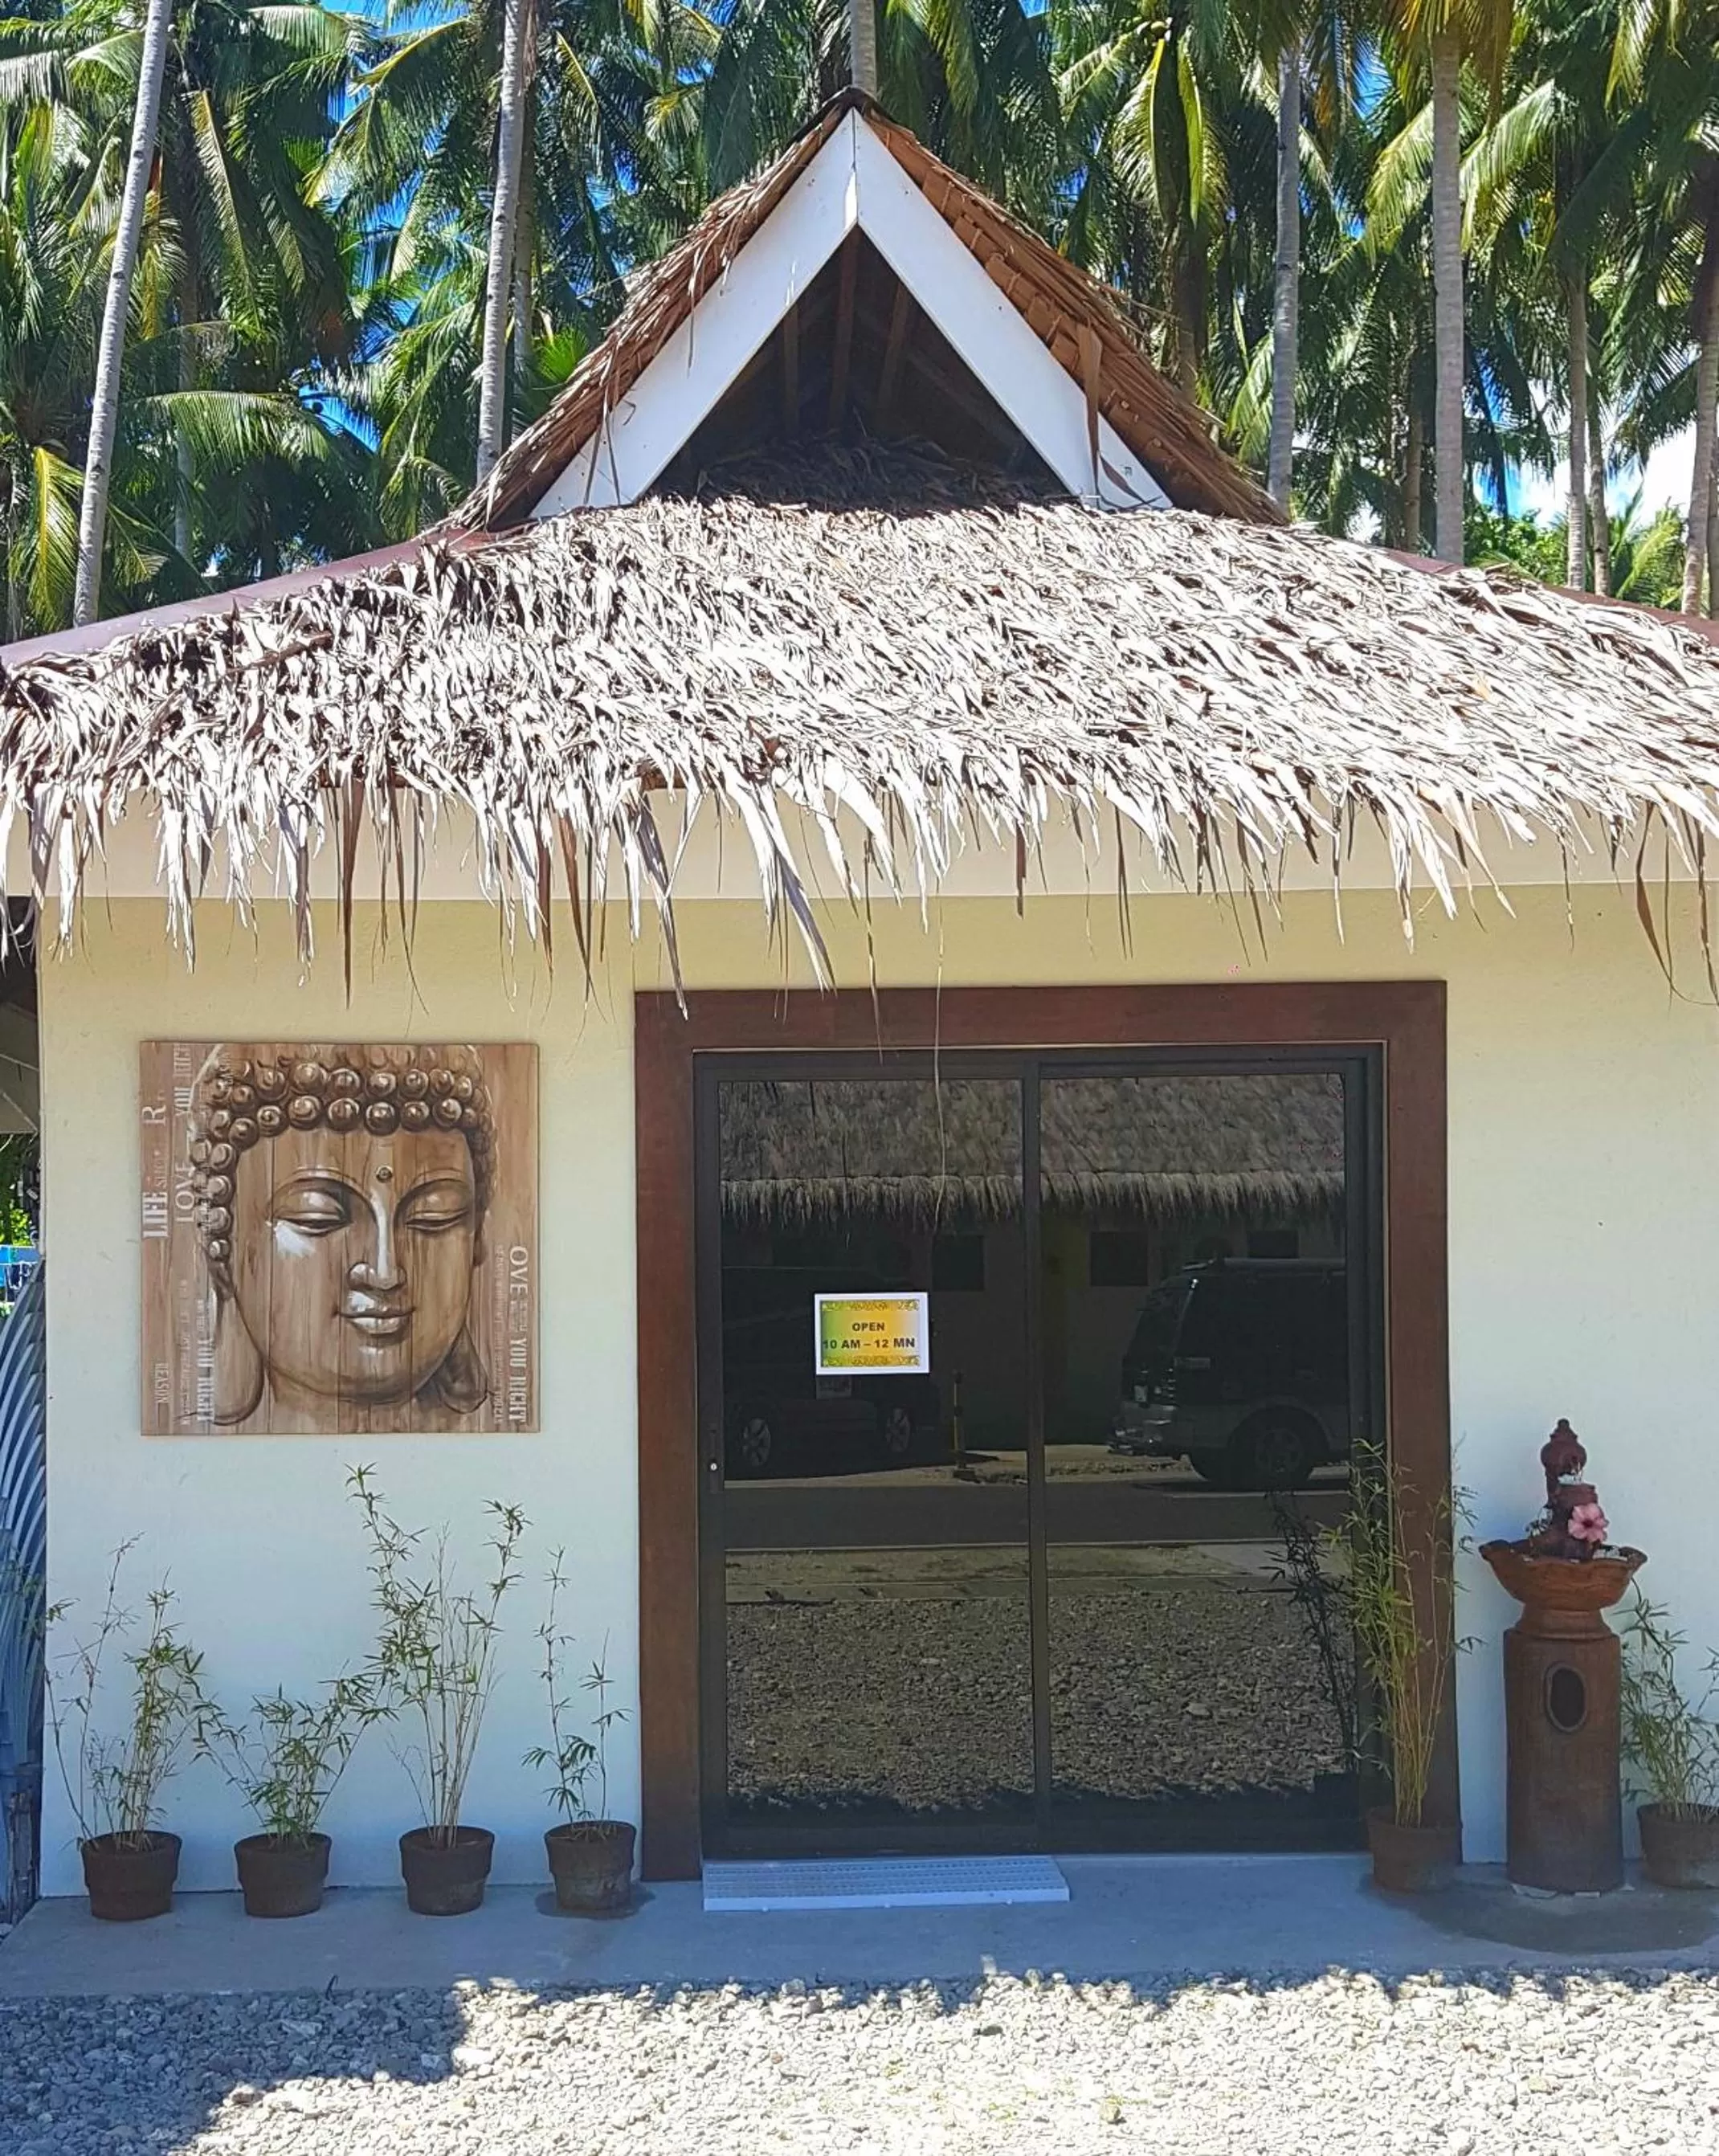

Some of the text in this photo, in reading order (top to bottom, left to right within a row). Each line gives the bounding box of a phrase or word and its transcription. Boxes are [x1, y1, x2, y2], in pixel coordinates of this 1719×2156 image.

[142, 1192, 168, 1238] LIFE
[175, 1162, 195, 1223] LOVE
[509, 1246, 529, 1295] OVE
[823, 1340, 838, 1350] 10
[841, 1339, 860, 1349] AM
[874, 1339, 888, 1349] 12
[893, 1337, 915, 1348] MN
[851, 1322, 885, 1332] OPEN
[509, 1338, 528, 1368] YOU
[508, 1376, 528, 1423] RIGHT
